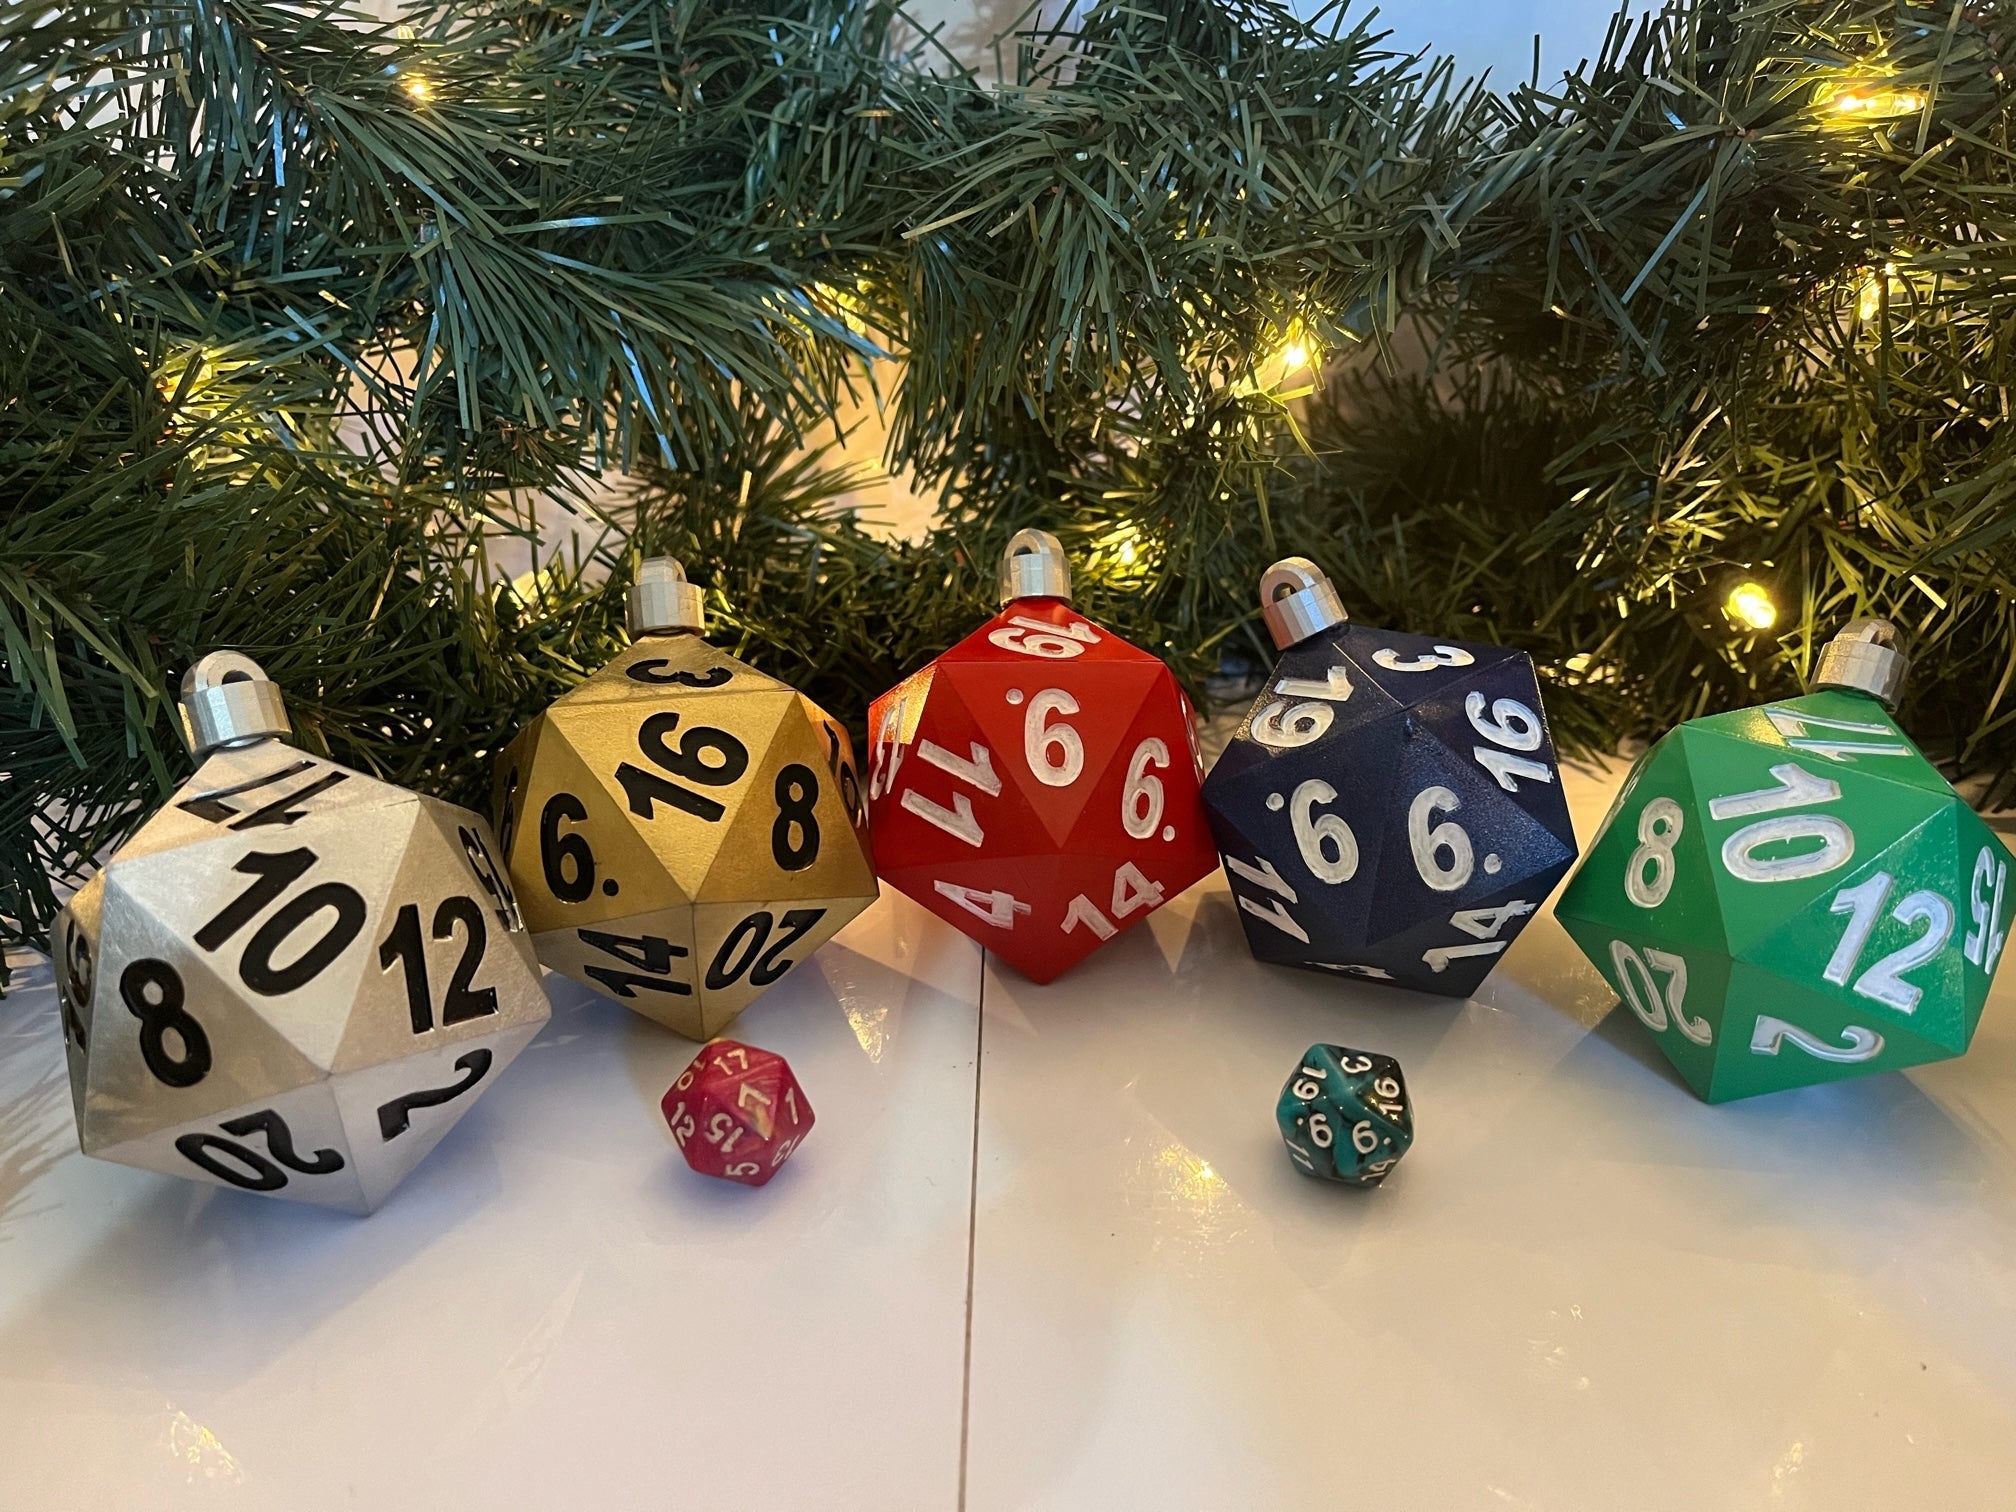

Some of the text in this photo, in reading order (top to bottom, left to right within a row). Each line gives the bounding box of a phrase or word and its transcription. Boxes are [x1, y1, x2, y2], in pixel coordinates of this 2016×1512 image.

[625, 658, 733, 688] 3
[988, 615, 1102, 659] 19
[1371, 645, 1475, 672] 3
[1250, 665, 1354, 748] 19
[1465, 691, 1554, 792] 16
[614, 712, 749, 822] 16
[901, 738, 1002, 848] 11
[771, 763, 821, 873] 8
[1624, 797, 1684, 908] 8
[1709, 762, 1855, 883] 10
[193, 847, 367, 997] 10
[934, 880, 1032, 930] 4
[1060, 861, 1165, 941] 14
[1227, 854, 1310, 944] 11
[1422, 899, 1537, 973] 14
[379, 895, 499, 1034] 12
[577, 928, 692, 997] 14
[704, 908, 828, 991] 20
[1822, 871, 1955, 1016] 12
[119, 958, 212, 1088] 8
[1609, 939, 1712, 1046] 20
[713, 1048, 748, 1075] 17
[738, 1082, 771, 1107] 7
[1292, 1066, 1327, 1100] 19
[1340, 1056, 1372, 1074] 3
[1374, 1076, 1403, 1115] 16
[670, 1102, 695, 1147] 12
[704, 1112, 744, 1152] 15
[785, 1087, 798, 1125] 1
[175, 1109, 345, 1192] 20
